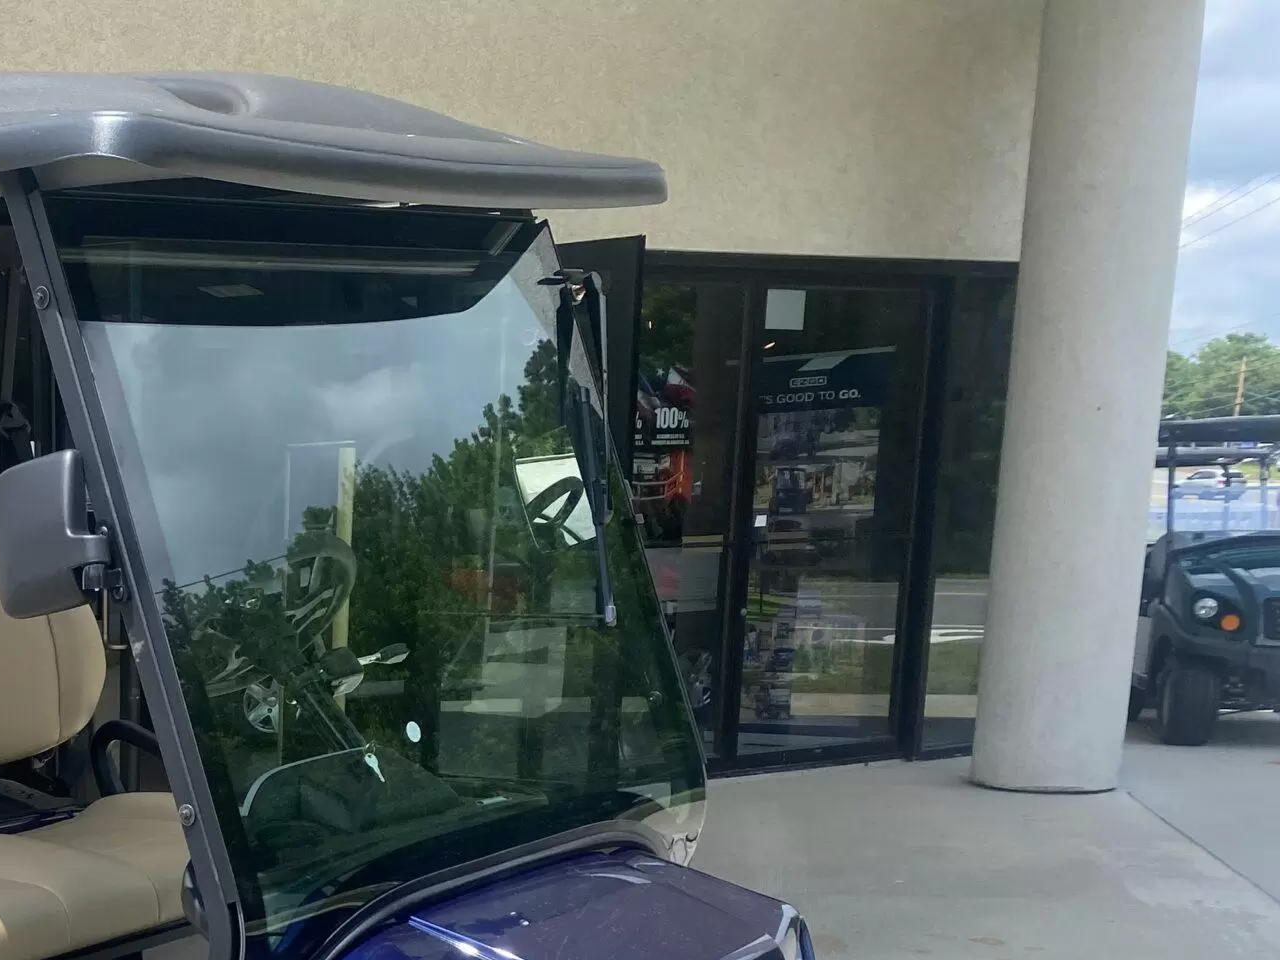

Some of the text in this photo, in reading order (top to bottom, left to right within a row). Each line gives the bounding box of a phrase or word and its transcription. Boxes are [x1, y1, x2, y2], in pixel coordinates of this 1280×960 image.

[776, 392, 814, 404] GOOD
[817, 390, 835, 400] TO
[839, 389, 861, 399] GO.
[654, 407, 689, 429] 100%
